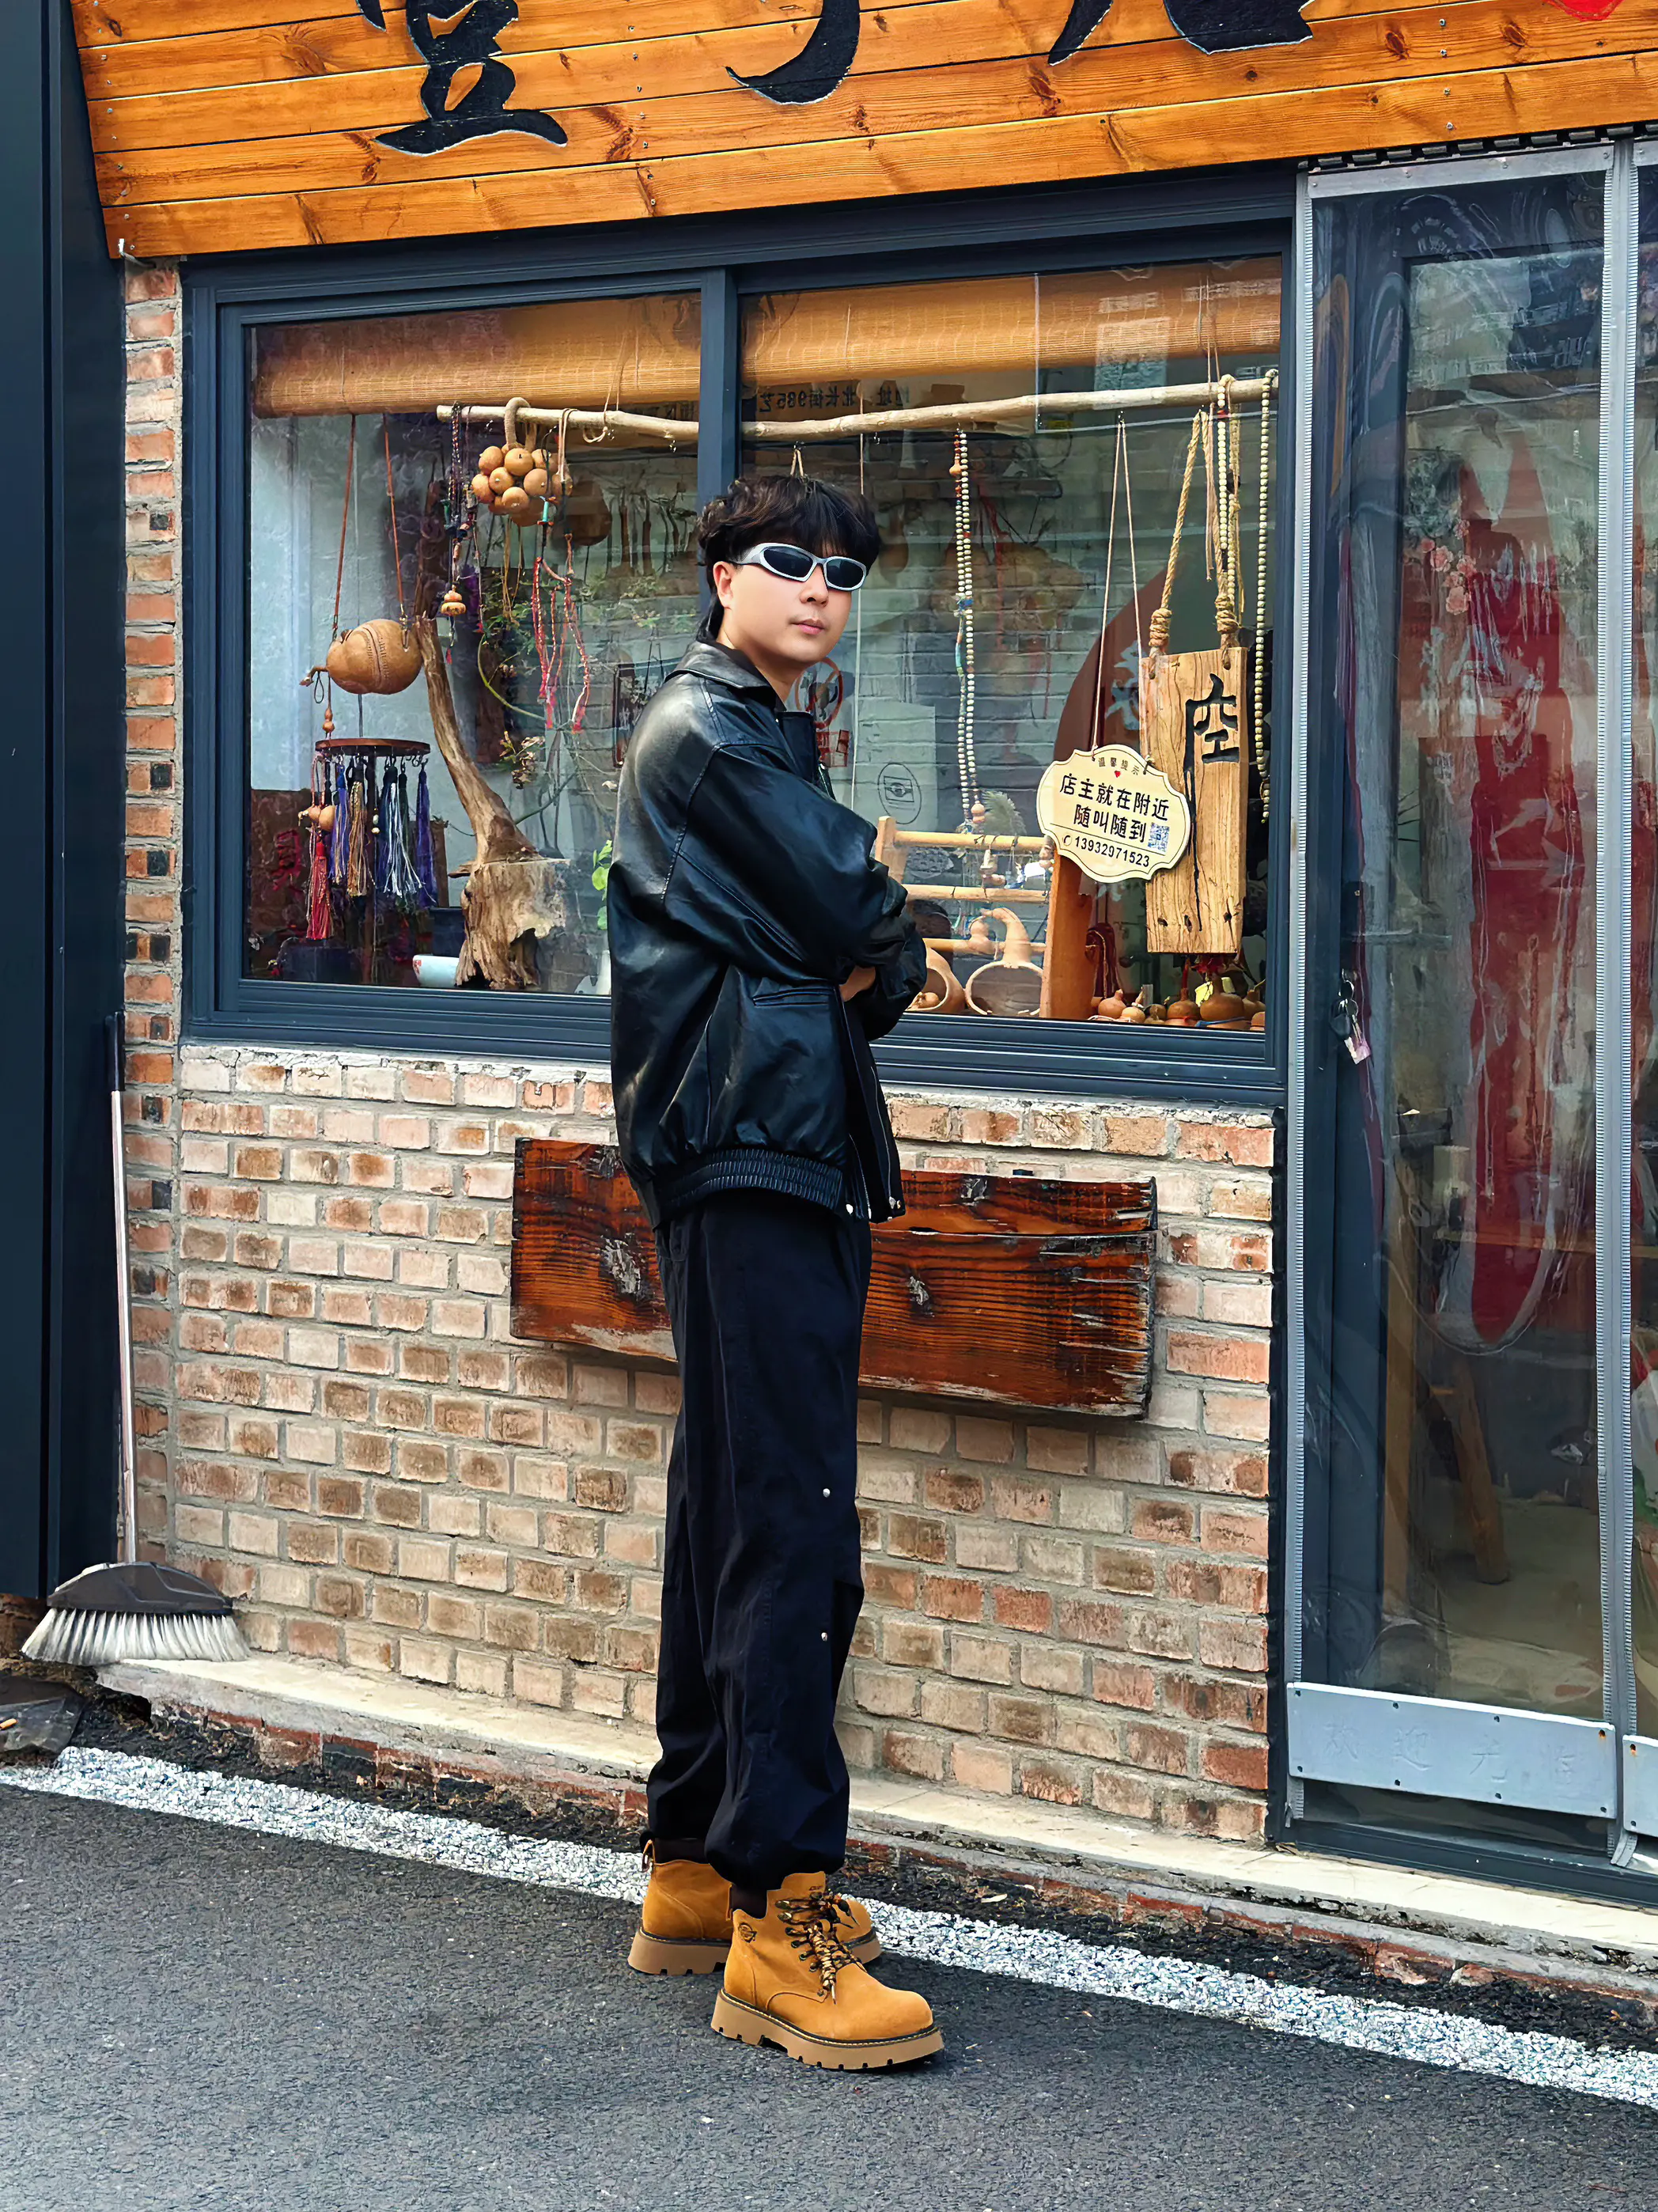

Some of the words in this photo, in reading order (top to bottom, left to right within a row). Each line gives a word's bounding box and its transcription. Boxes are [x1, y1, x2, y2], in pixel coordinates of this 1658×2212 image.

[1098, 757, 1140, 775] 温馨提示
[1059, 773, 1169, 821] 店主就在附近
[1073, 804, 1146, 843] 随叫随到
[1075, 836, 1149, 867] 13932971523
